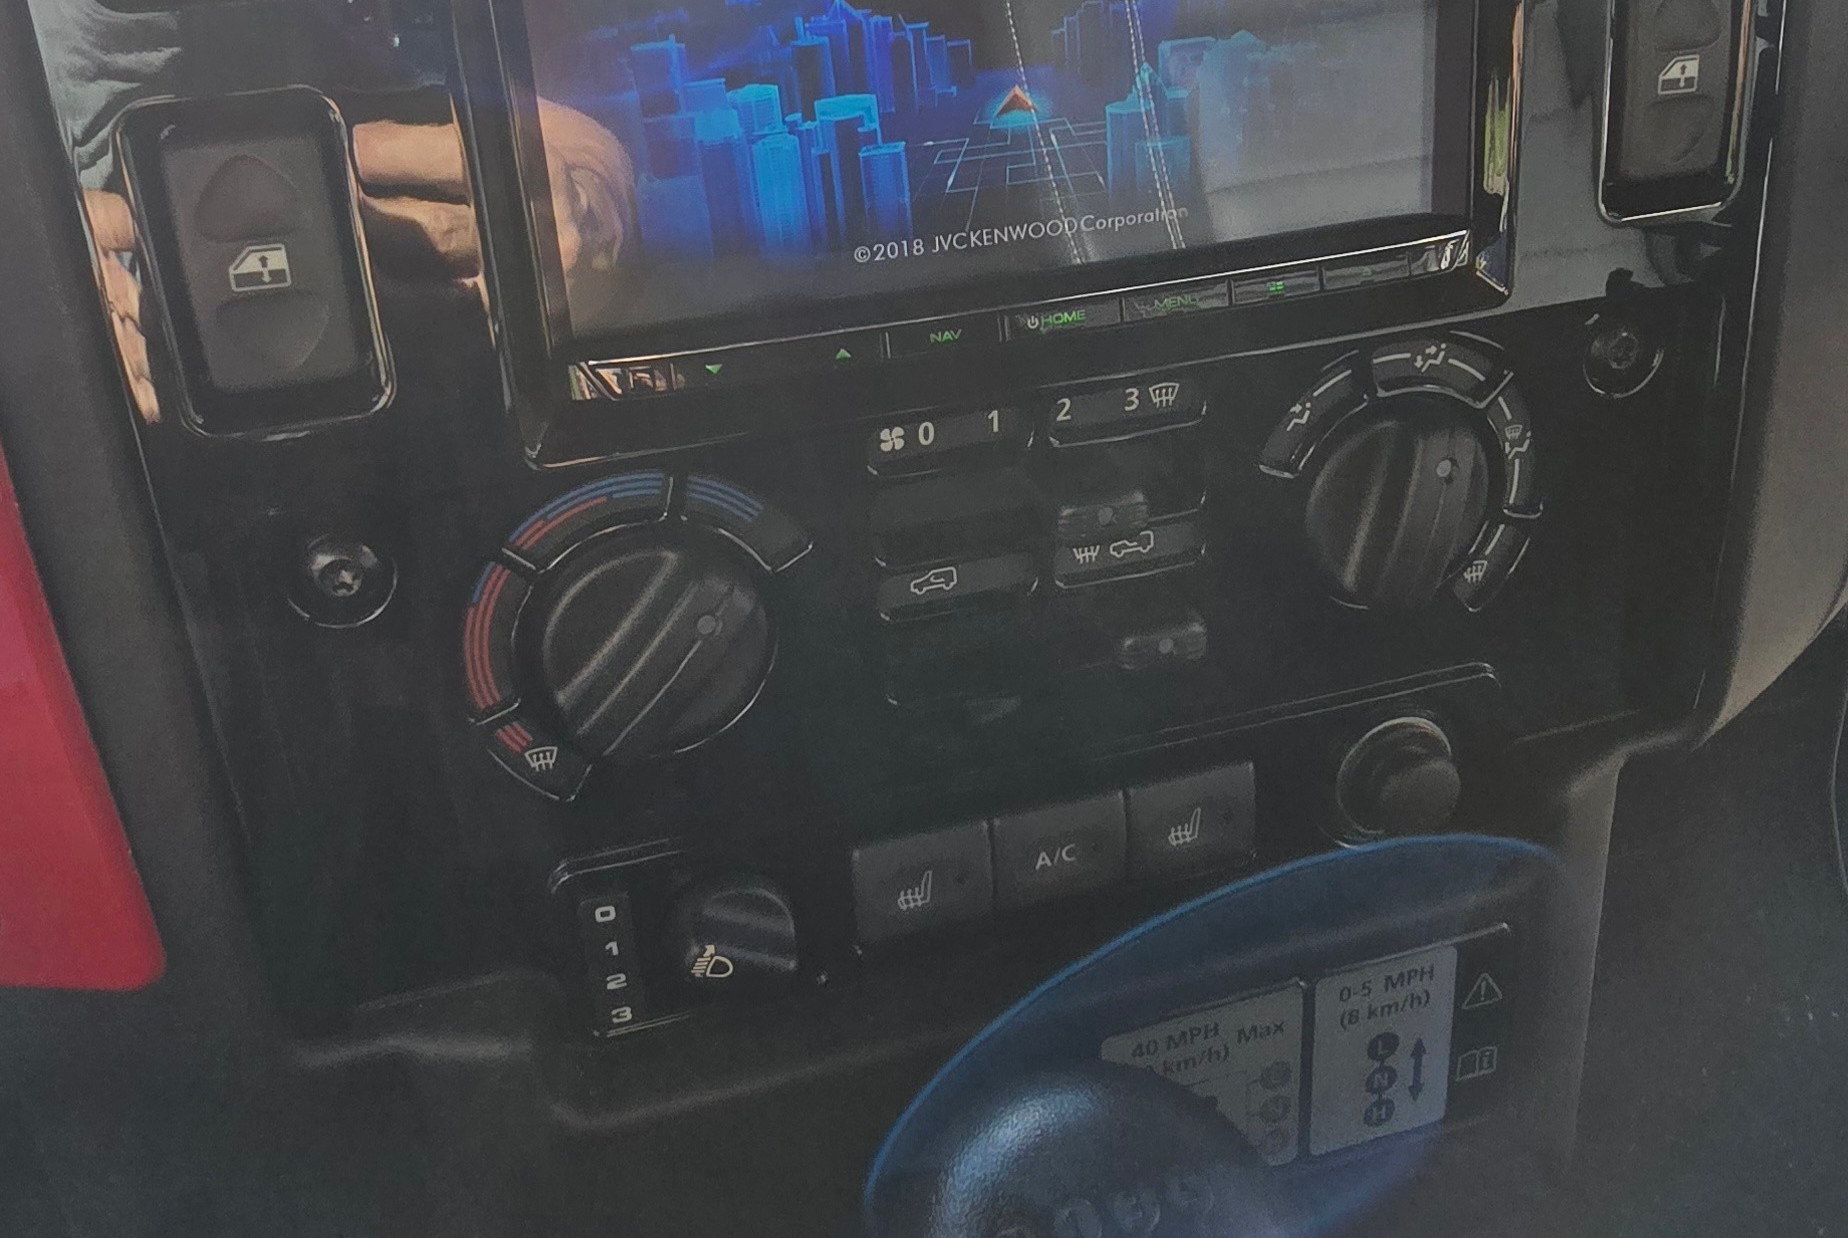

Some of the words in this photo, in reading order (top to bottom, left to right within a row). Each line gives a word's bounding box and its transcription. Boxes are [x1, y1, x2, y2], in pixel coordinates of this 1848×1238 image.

[1041, 309, 1086, 327] HOME
[929, 328, 963, 345] NAV
[1056, 398, 1072, 422] 2
[1125, 388, 1140, 411] 3
[918, 422, 935, 446] 0
[988, 410, 1000, 433] 1
[1035, 844, 1076, 871] A/C
[594, 905, 617, 923] 0
[605, 941, 619, 956] 1
[606, 973, 628, 990] 2
[1339, 979, 1373, 1002] 0-5
[1384, 963, 1435, 993] MPH
[611, 1006, 633, 1024] 3
[1366, 989, 1431, 1020] km/h)
[1131, 1038, 1159, 1059] 40
[1166, 1022, 1220, 1051] MPH
[1236, 1020, 1285, 1045] Max
